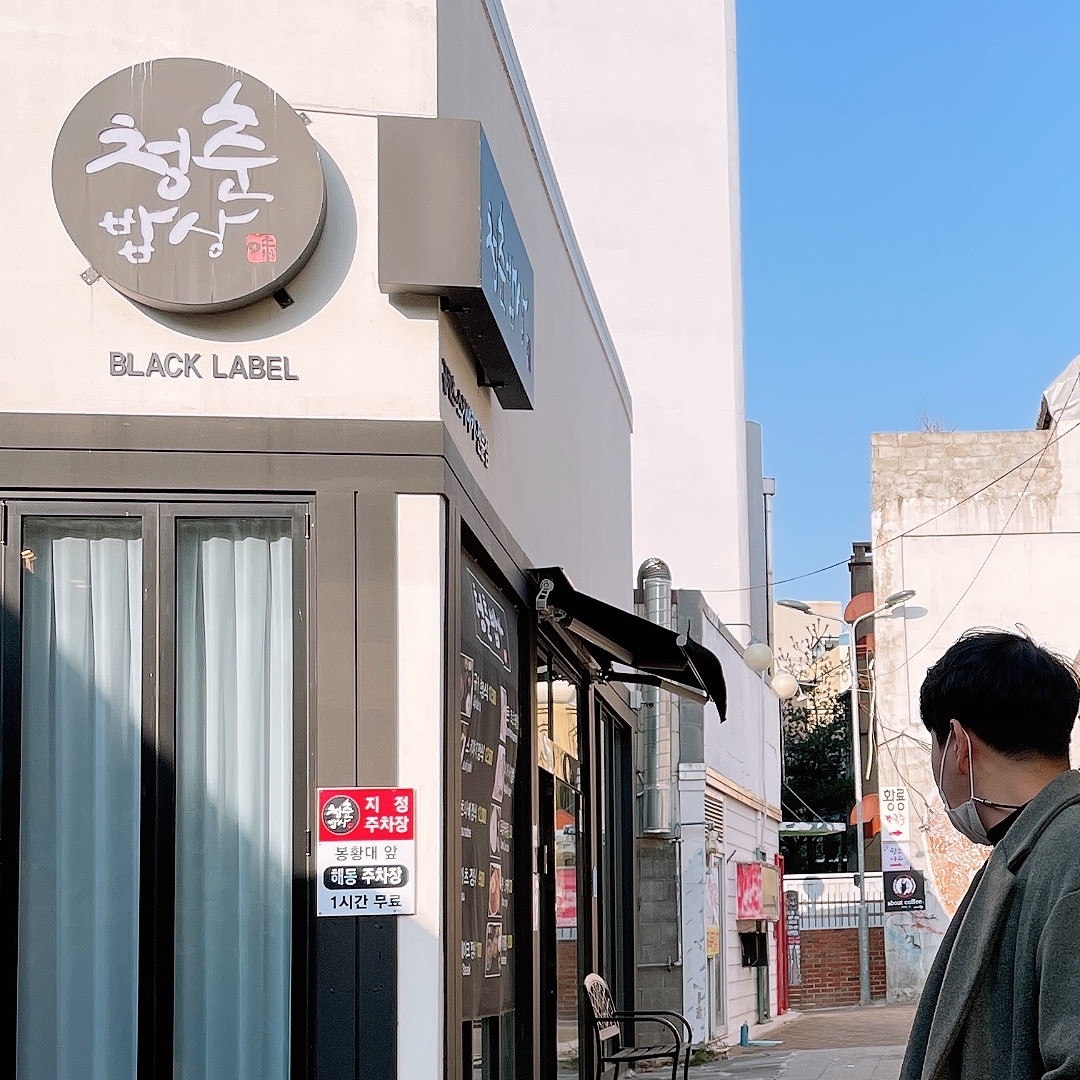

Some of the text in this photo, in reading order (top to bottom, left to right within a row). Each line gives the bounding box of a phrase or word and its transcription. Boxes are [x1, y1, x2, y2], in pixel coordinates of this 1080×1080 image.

[86, 80, 279, 202] 청춘
[98, 205, 260, 264] 밥상
[109, 351, 300, 381] BLACK LABEL
[364, 816, 409, 834] 주차장
[335, 845, 398, 861] 봉황대 앞
[330, 866, 403, 886] 해동 주차장
[330, 894, 402, 910] 1시간 무료
[887, 899, 904, 907] about
